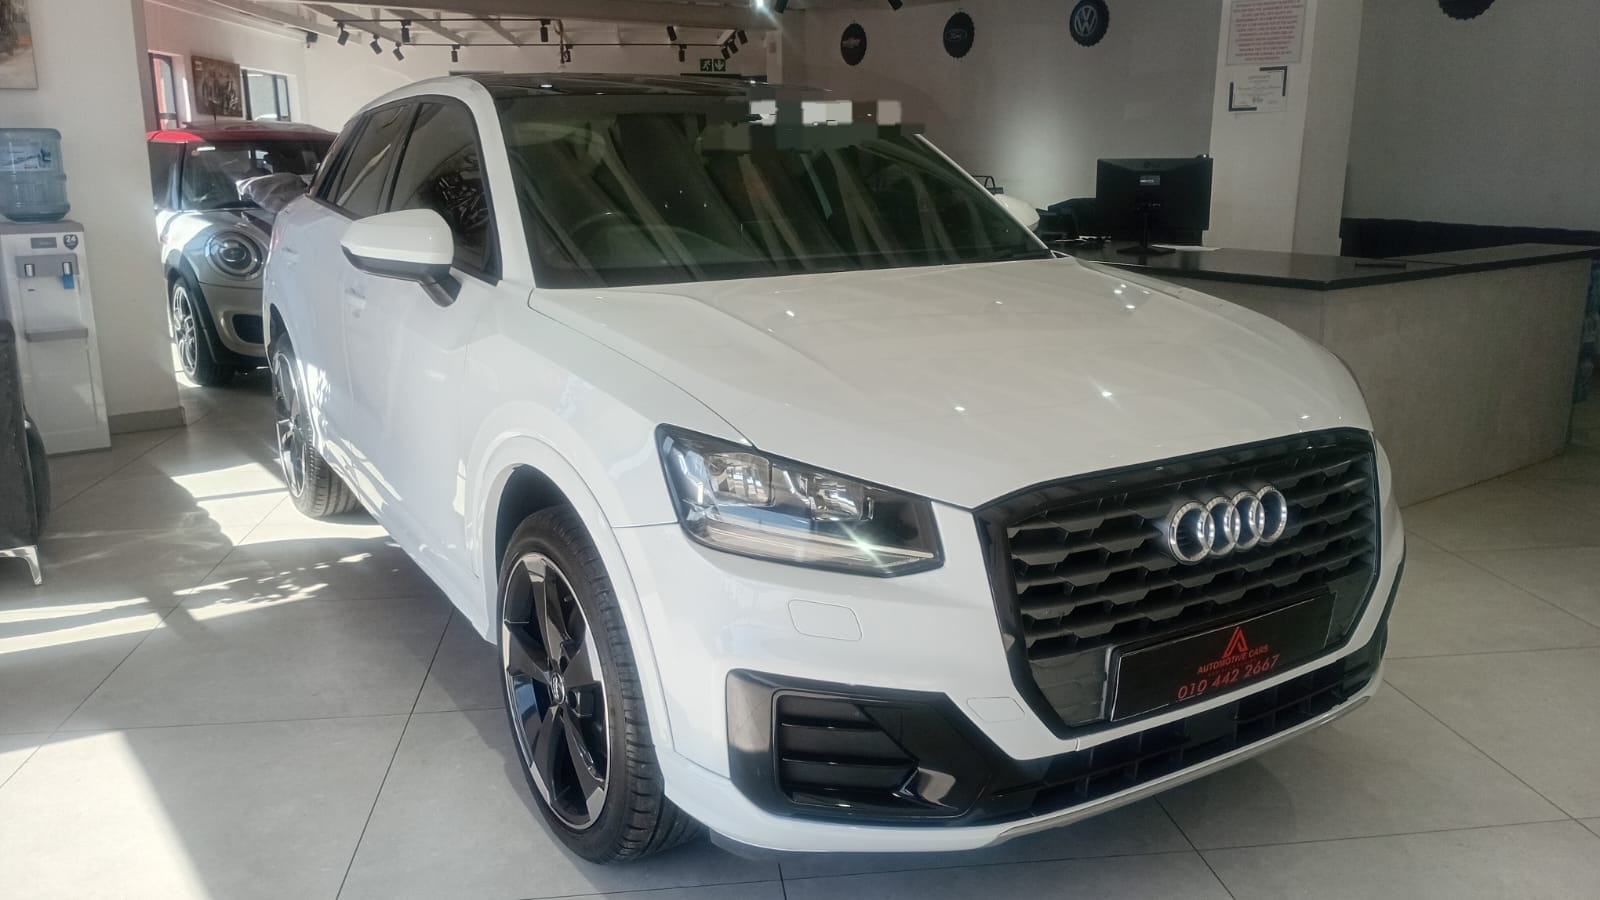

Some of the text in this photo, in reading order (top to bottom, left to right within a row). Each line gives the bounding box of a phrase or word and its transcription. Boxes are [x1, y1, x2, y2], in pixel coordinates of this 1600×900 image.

[65, 235, 76, 243] 24
[1198, 653, 1248, 673] AUTOMOTIVE
[1249, 645, 1268, 658] CARS
[1178, 679, 1207, 699] 010
[1211, 668, 1240, 687] 442
[1245, 654, 1280, 677] 2667
